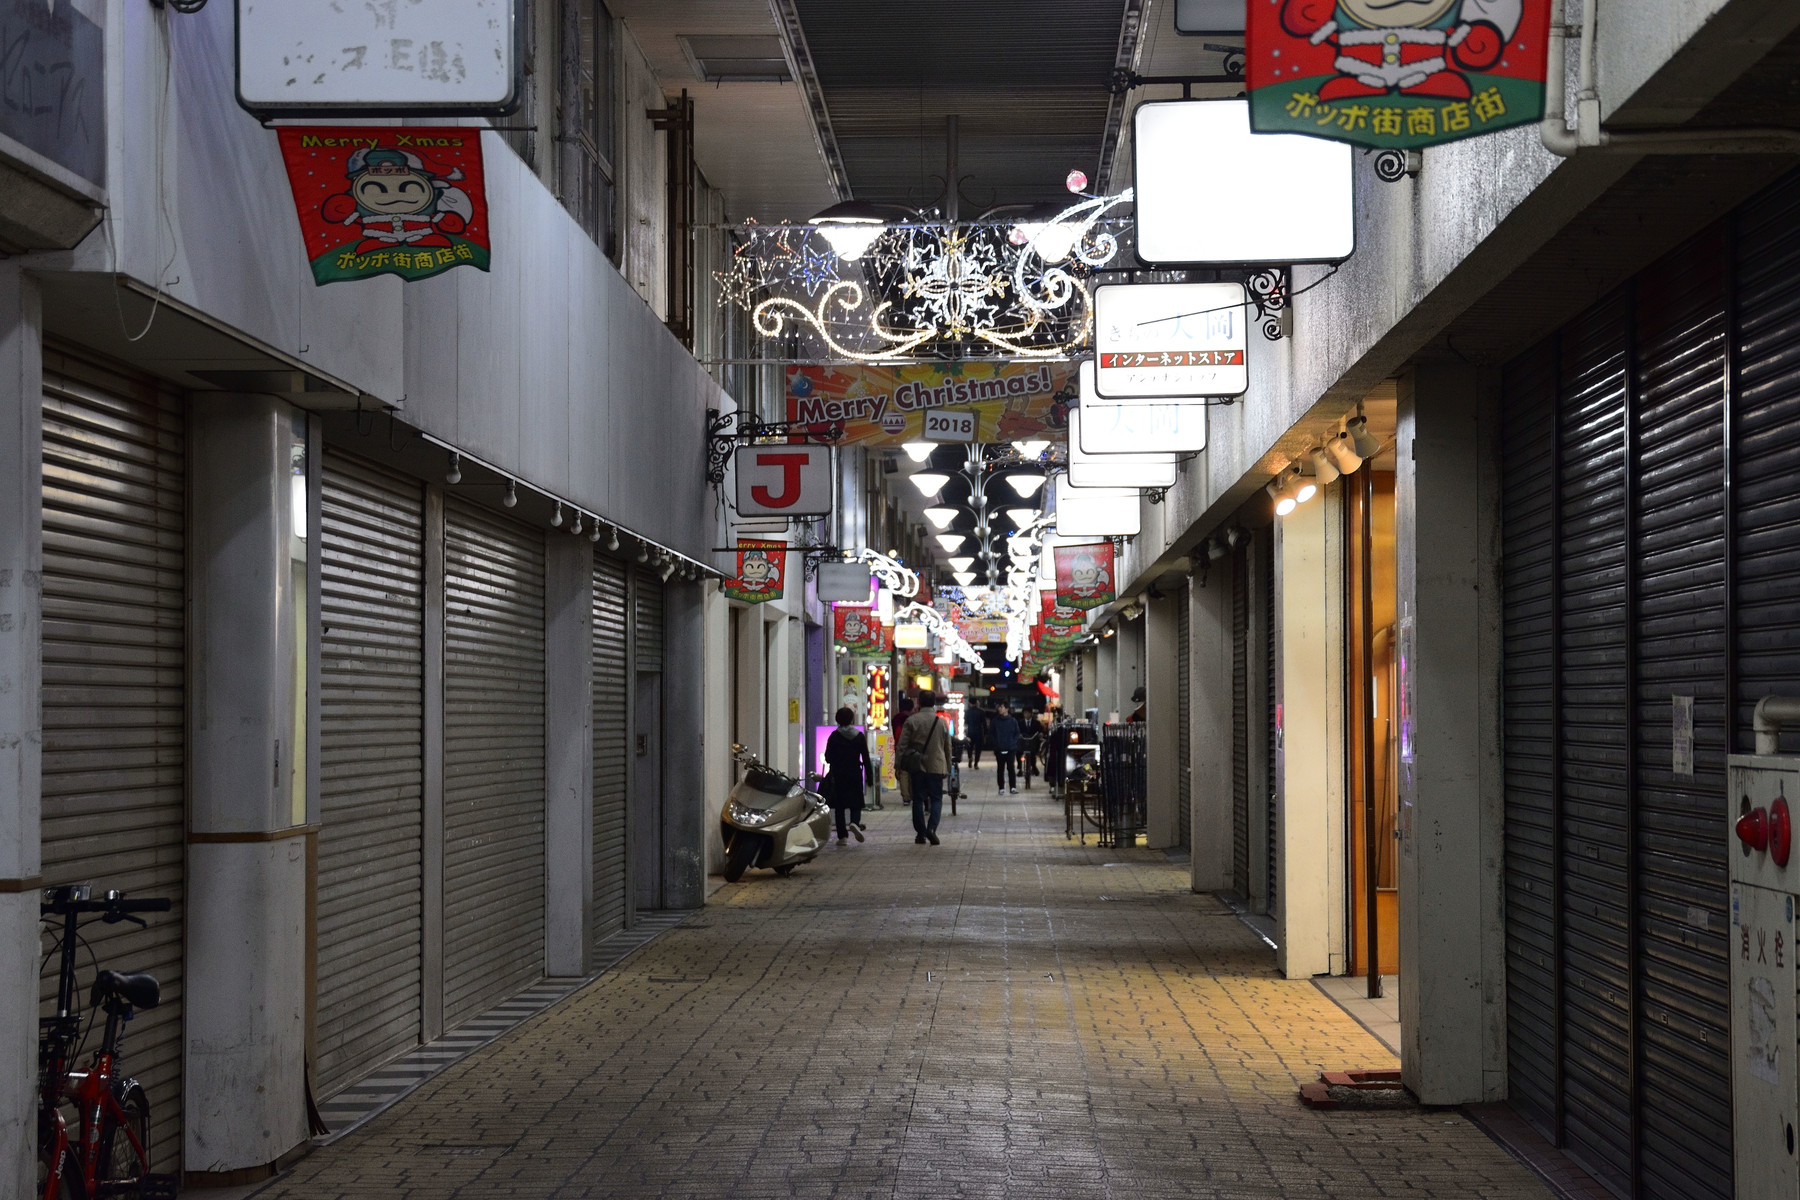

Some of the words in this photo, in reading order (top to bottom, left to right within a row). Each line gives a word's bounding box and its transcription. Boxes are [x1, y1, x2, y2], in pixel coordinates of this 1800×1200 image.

[1285, 87, 1506, 135] ポッポ街商店街
[302, 134, 379, 150] Merry
[396, 133, 464, 147] Xmas
[336, 244, 474, 270] ポッポ街商店街
[1109, 351, 1236, 367] インターネットストア
[799, 394, 888, 424] Merry
[895, 367, 1052, 411] Christmas!
[928, 416, 973, 434] 2018
[751, 453, 810, 509] J
[1741, 923, 1785, 968] 消火栓
[55, 1150, 66, 1180] Jeep
